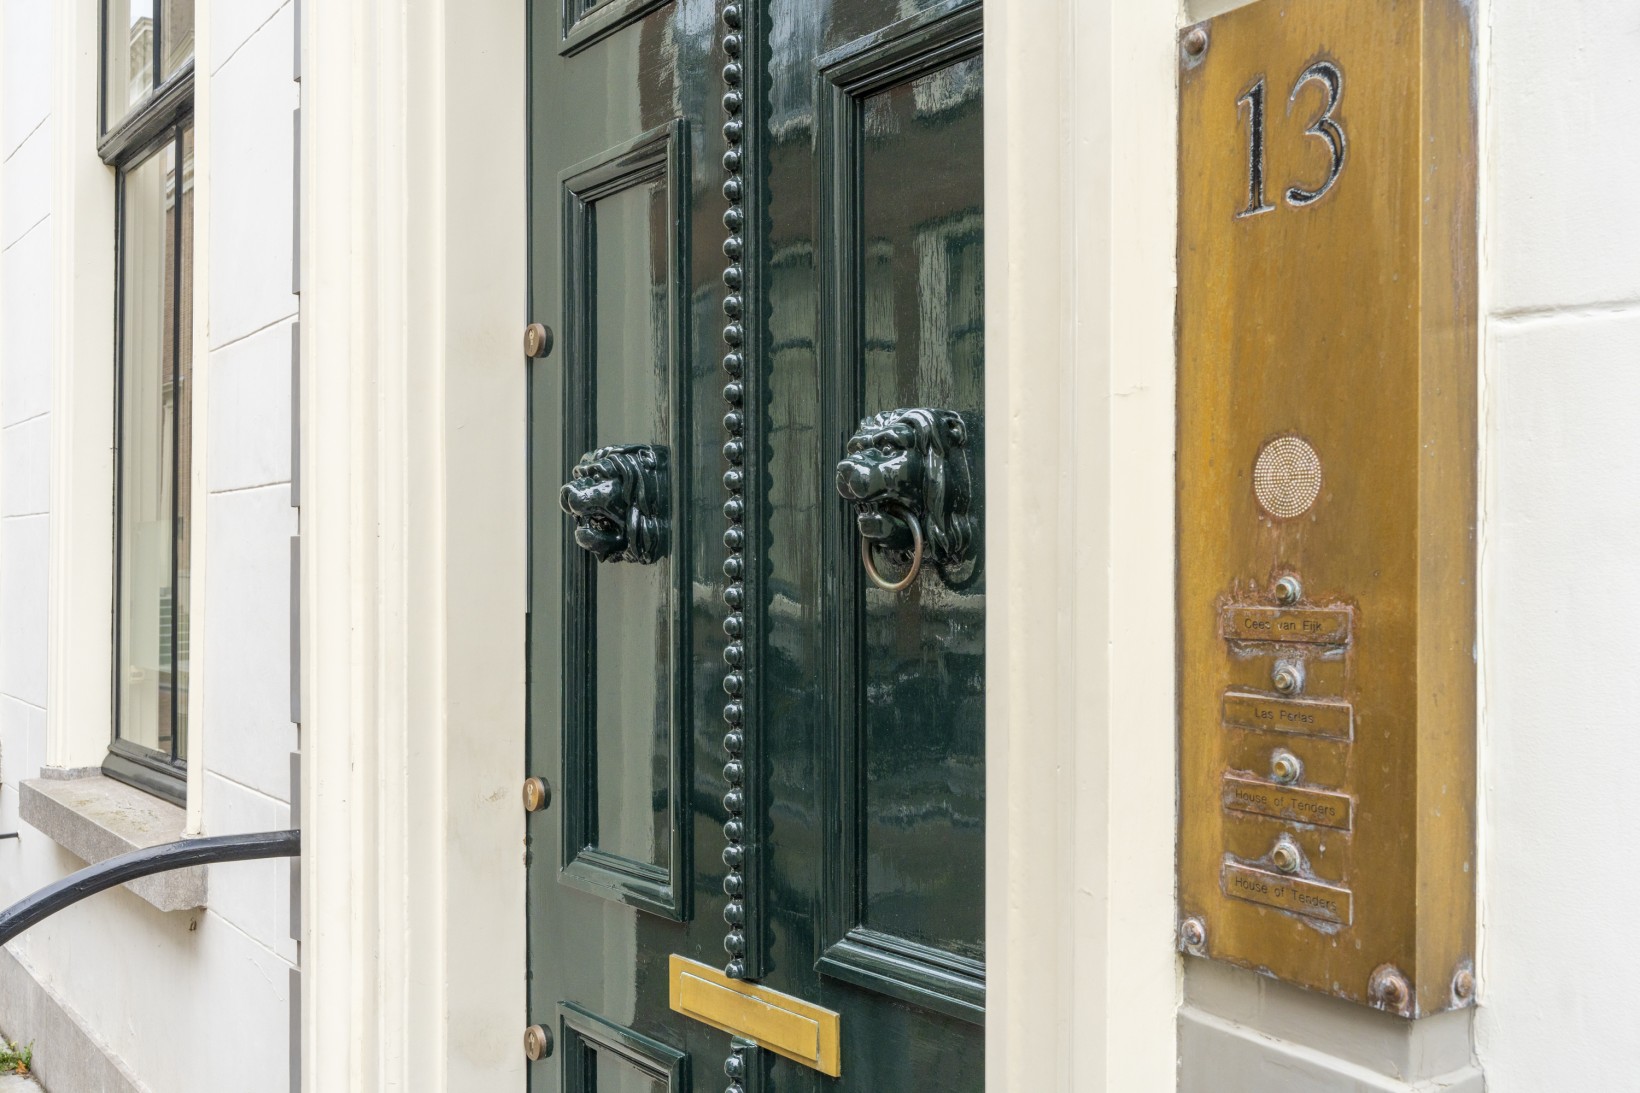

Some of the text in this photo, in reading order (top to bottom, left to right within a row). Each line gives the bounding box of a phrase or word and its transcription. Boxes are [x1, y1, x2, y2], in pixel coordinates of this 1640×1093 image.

[1235, 59, 1346, 219] 13
[1244, 618, 1271, 630] Cees
[1302, 620, 1322, 634] Eijk
[1254, 708, 1273, 720] Las
[1235, 789, 1336, 817] House of Tenders
[1235, 876, 1337, 912] House of Tenders
